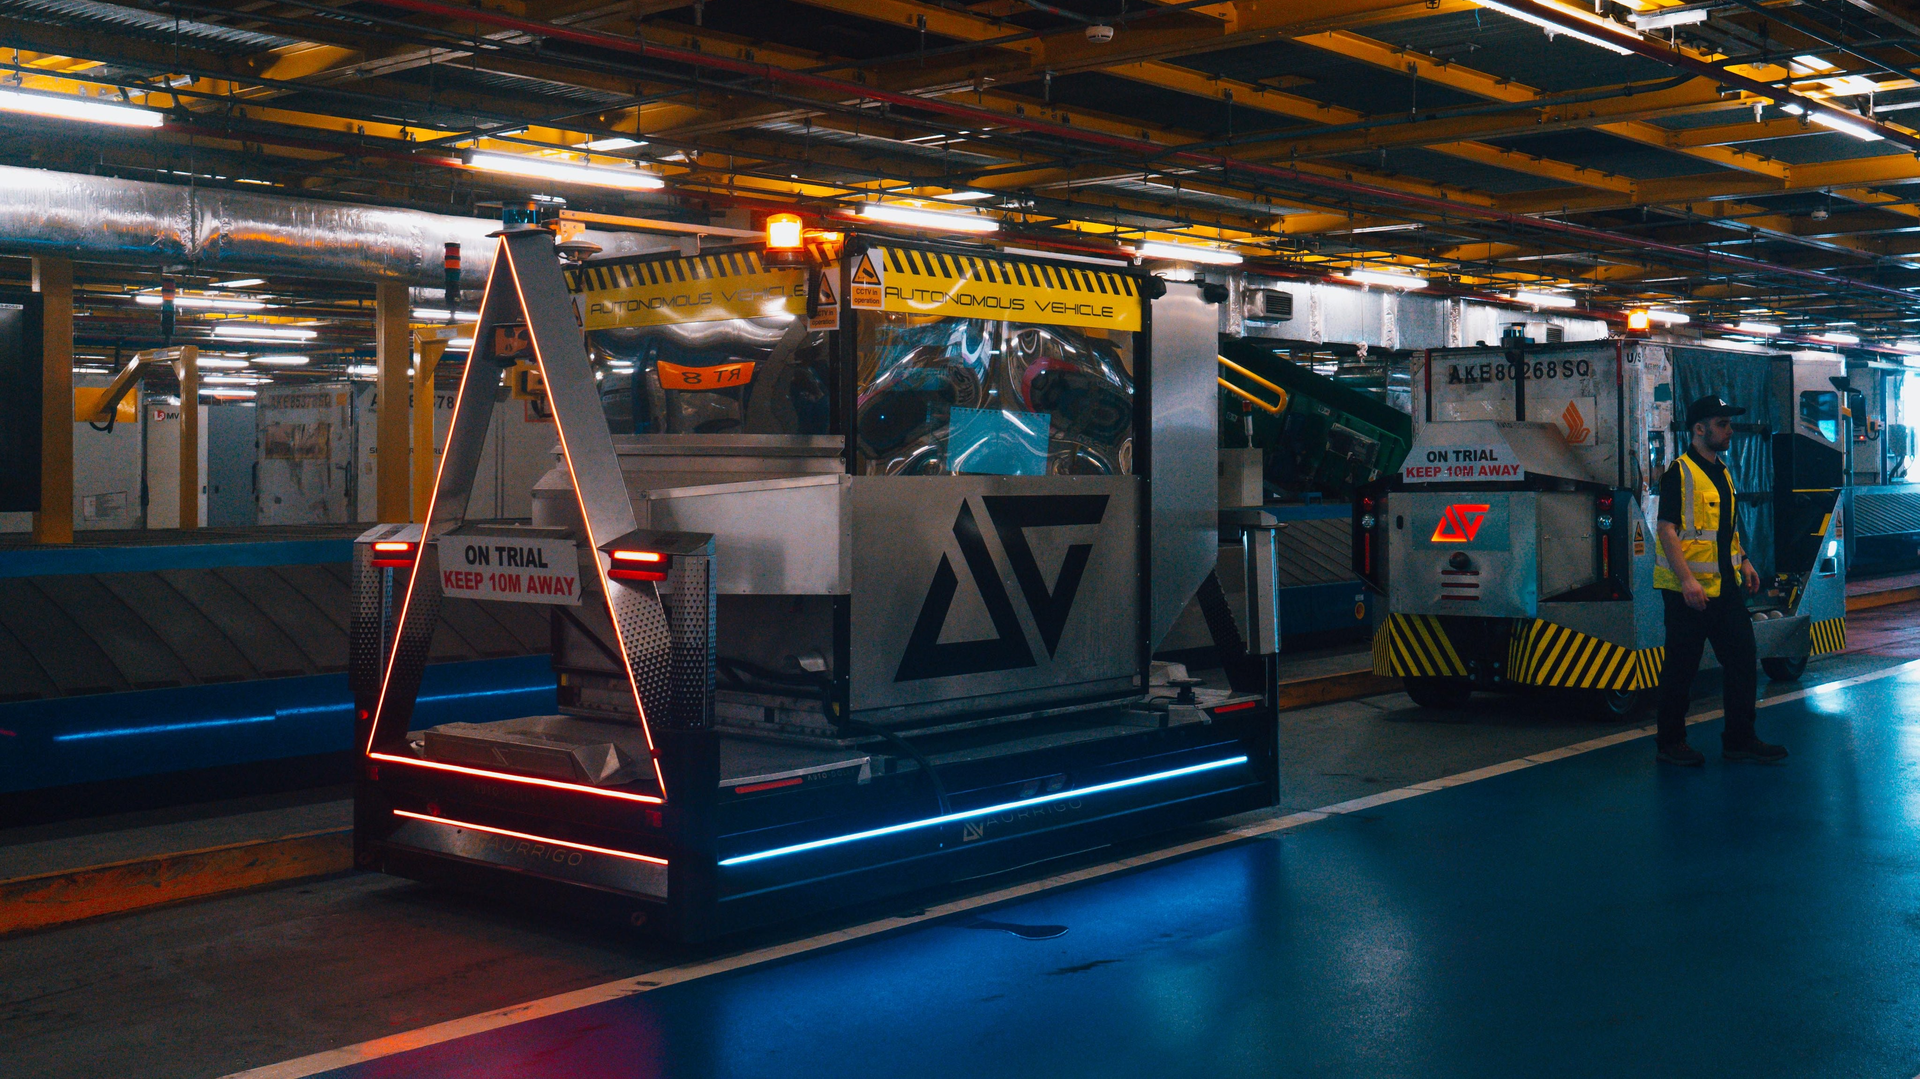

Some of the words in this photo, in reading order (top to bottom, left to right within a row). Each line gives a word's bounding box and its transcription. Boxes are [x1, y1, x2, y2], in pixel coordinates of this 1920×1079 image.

[590, 292, 713, 316] AUTONOMOUS
[722, 284, 804, 303] VEHICLE
[854, 297, 880, 305] operation
[855, 288, 872, 296] CCTV
[885, 286, 1025, 311] AUTONOMOUS
[1034, 300, 1114, 318] VEHICLE
[811, 319, 835, 327] operation
[1426, 450, 1448, 463] ON
[1452, 449, 1499, 462] TRIAL
[1406, 466, 1442, 478] KEEP
[1446, 465, 1474, 477] 10M
[1478, 464, 1520, 477] AWAY
[465, 545, 490, 566] ON
[495, 546, 548, 569] TRIAL
[444, 570, 483, 591] KEEP
[489, 572, 521, 593] 10M
[527, 575, 575, 596] AWAY
[986, 798, 1083, 827] AURRIGO
[487, 836, 583, 866] AURRIGO
